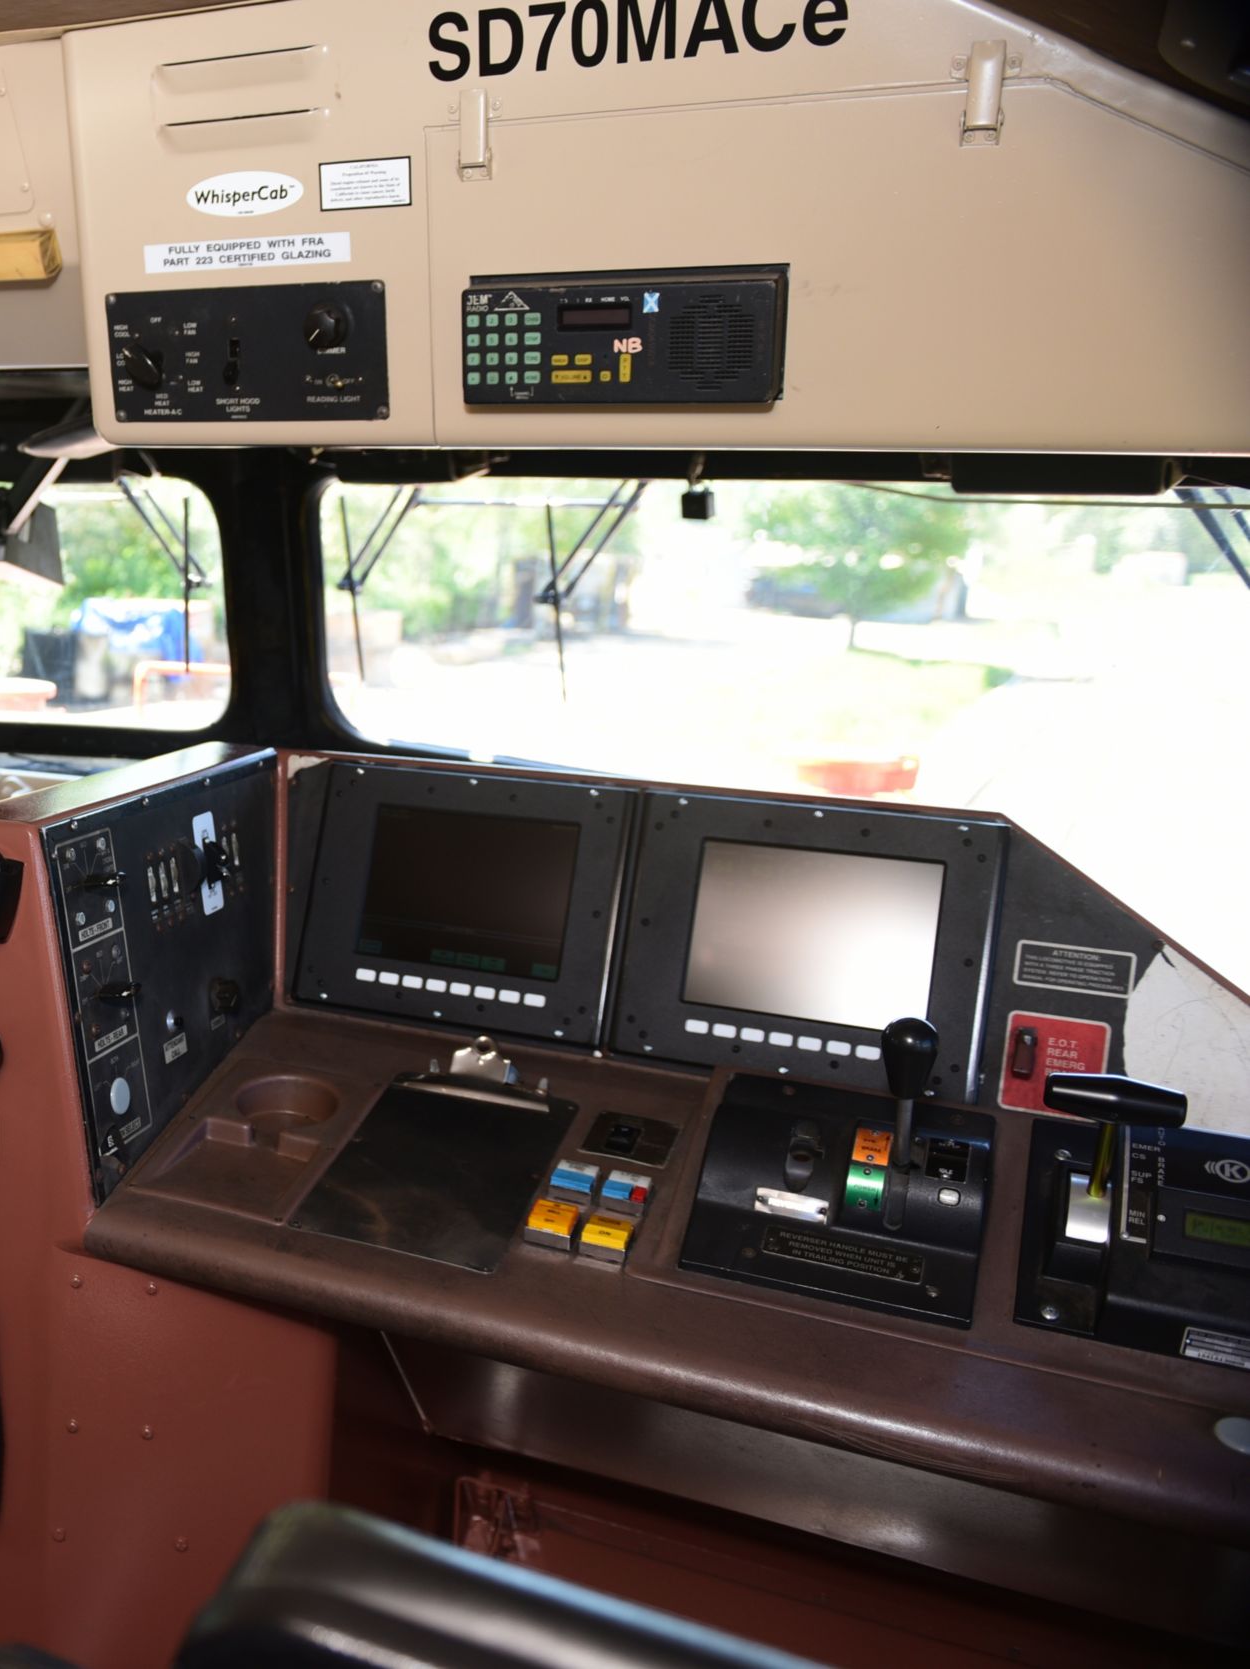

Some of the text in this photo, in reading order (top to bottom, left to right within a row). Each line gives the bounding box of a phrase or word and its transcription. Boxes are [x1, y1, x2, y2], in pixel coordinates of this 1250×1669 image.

[194, 185, 289, 207] WhisperCab
[168, 237, 324, 255] FULLY EQUIPPED WITH FRA
[163, 248, 332, 267] PART 223 CERTIFIED GLAZING
[613, 337, 643, 353] NB
[240, 397, 260, 405] HOOD
[226, 405, 250, 413] LIGHTS
[1047, 1048, 1078, 1059] REAR
[1046, 1058, 1086, 1071] EMERG
[1132, 1143, 1161, 1153] EMER
[1131, 1152, 1147, 1160] CS
[1131, 1170, 1152, 1178] SUP
[1129, 1210, 1146, 1218] MIN
[1128, 1217, 1146, 1226] REL
[780, 1231, 909, 1263] REVERSER HANDLE MUST BE
[788, 1240, 833, 1255] REMOVED
[834, 1249, 862, 1260] WHEN
[864, 1256, 885, 1266] UNIT
[792, 1249, 891, 1275] IN TRAILING POSITION
